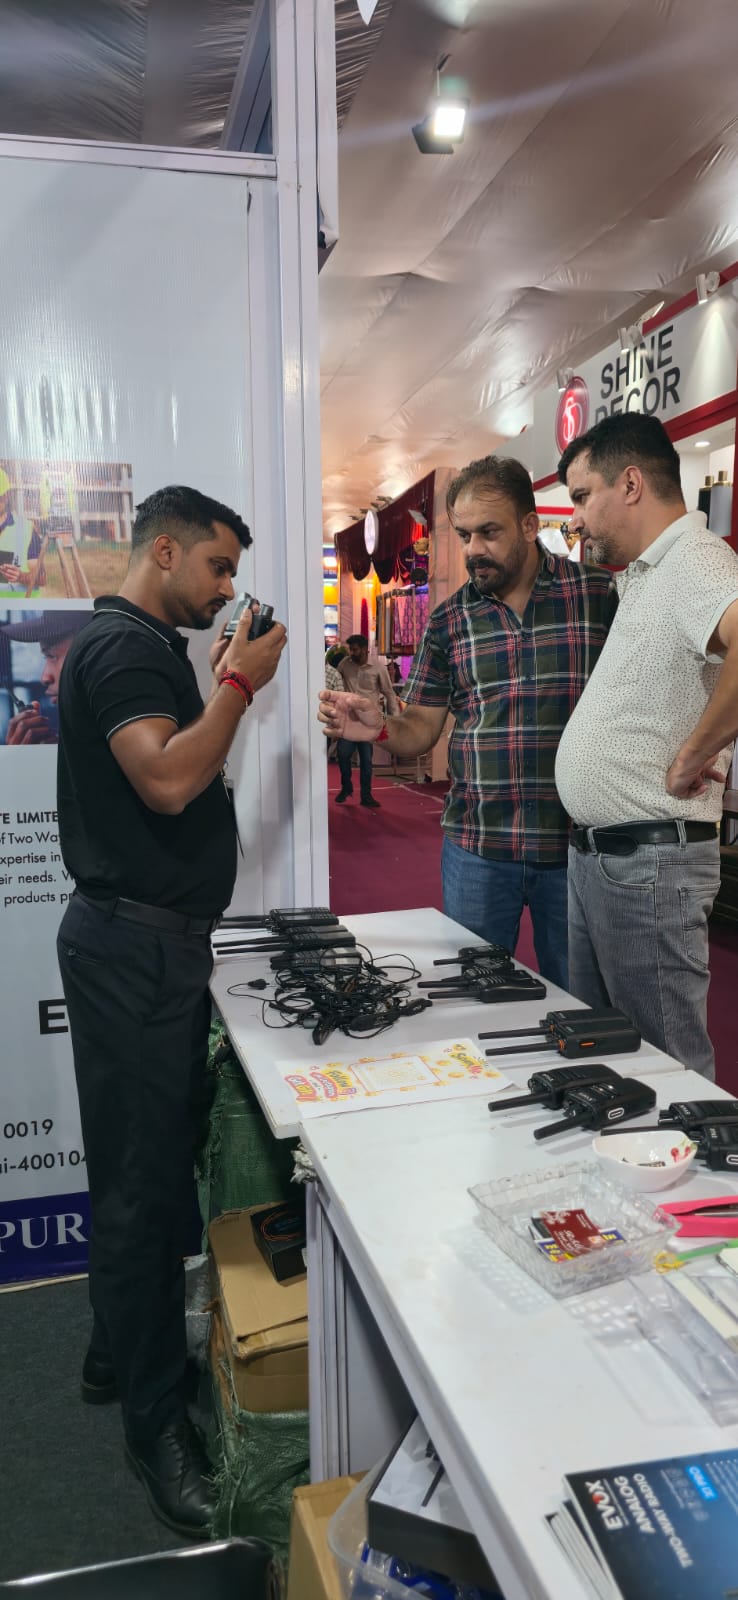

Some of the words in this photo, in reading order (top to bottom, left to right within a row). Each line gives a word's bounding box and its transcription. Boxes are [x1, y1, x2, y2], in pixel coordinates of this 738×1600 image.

[601, 324, 673, 399] SHINE
[8, 832, 33, 845] Two
[51, 851, 61, 862] in
[18, 870, 56, 884] needs.
[4, 891, 56, 908] products
[3, 1118, 54, 1139] 0019
[0, 1150, 86, 1175] i-40010
[633, 1473, 661, 1508] RADIO
[585, 1480, 623, 1530] EVOX
[614, 1475, 656, 1533] ANALOG
[652, 1507, 693, 1568] TWO-WAY
